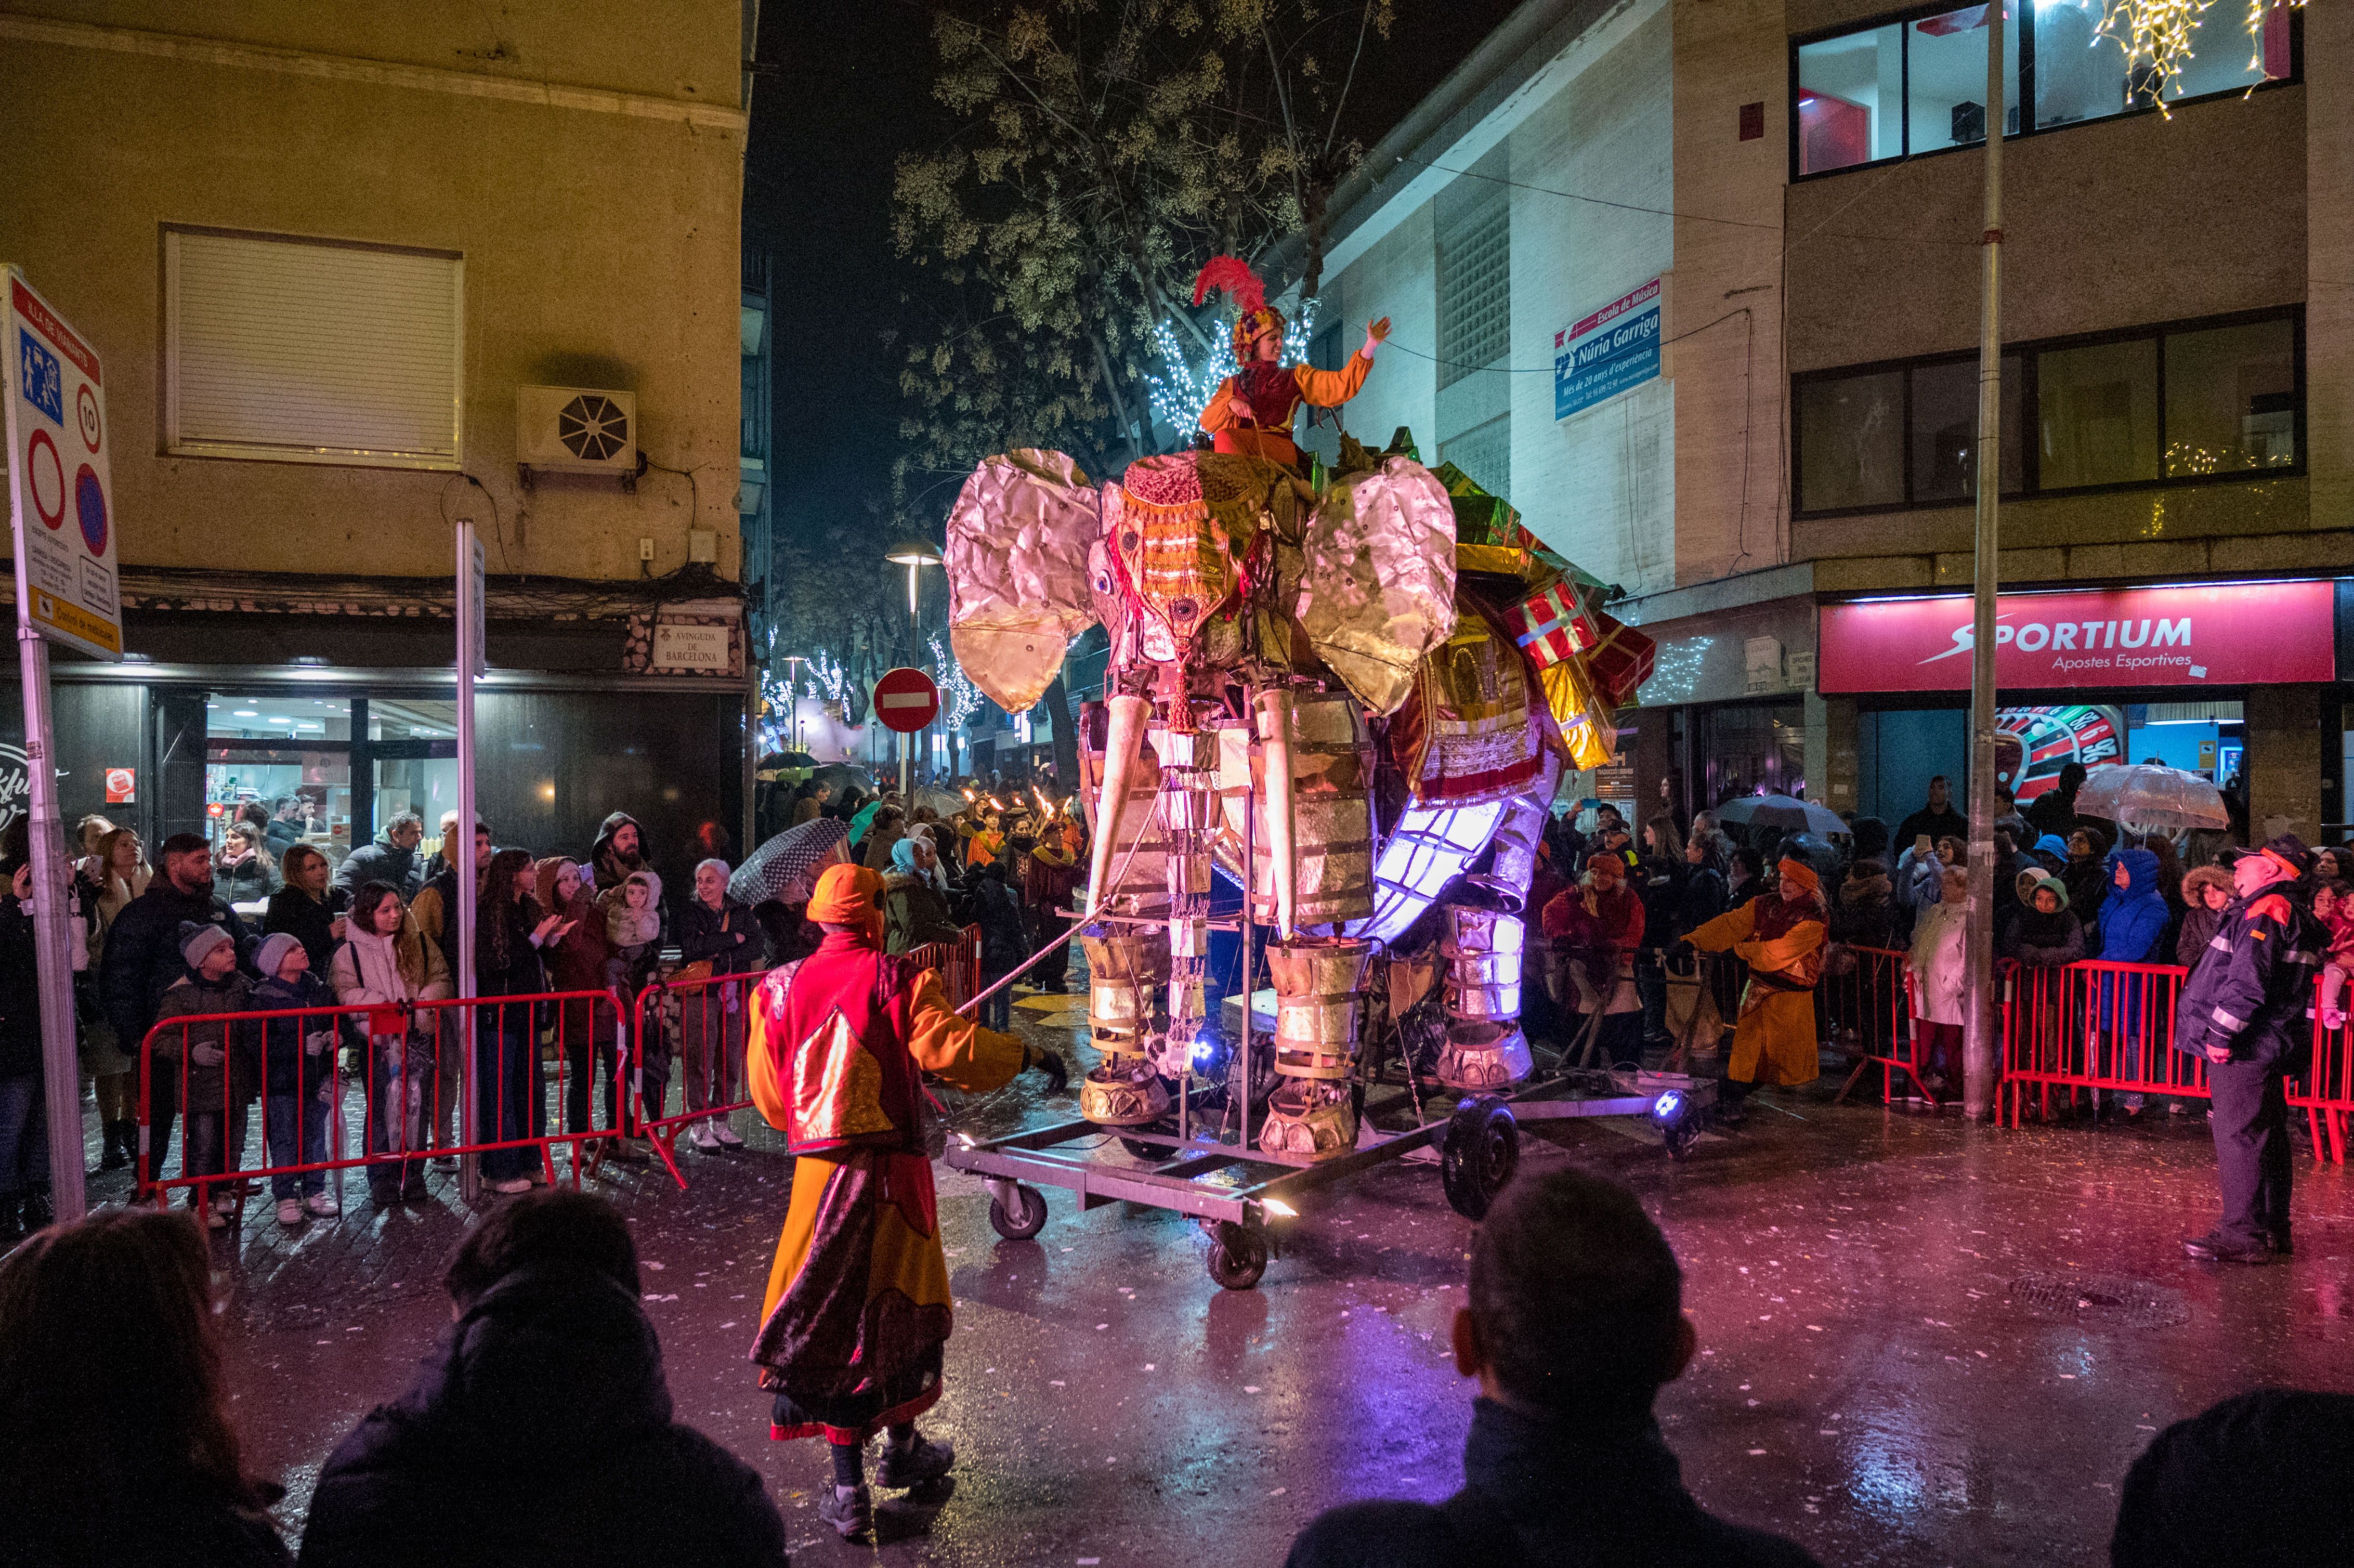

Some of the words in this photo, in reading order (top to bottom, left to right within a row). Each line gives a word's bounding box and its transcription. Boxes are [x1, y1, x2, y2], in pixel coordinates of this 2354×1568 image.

[1598, 305, 1619, 324] Escola
[1621, 298, 1630, 312] de
[1632, 284, 1658, 305] Música
[1578, 336, 1610, 366] Núria
[1614, 313, 1659, 347] Garriga
[1563, 385, 1575, 397] Més
[1576, 378, 1584, 391] de
[1585, 375, 1593, 388] 20
[1594, 370, 1608, 384] anys
[1609, 348, 1653, 375] d'experiència
[84, 406, 95, 432] 10
[676, 632, 716, 641] AVINGUDA
[1916, 613, 2192, 665] SPORTIUM
[666, 652, 717, 662] BARCELONA
[2052, 656, 2110, 673] Apostes
[2116, 652, 2192, 670] Esportives
